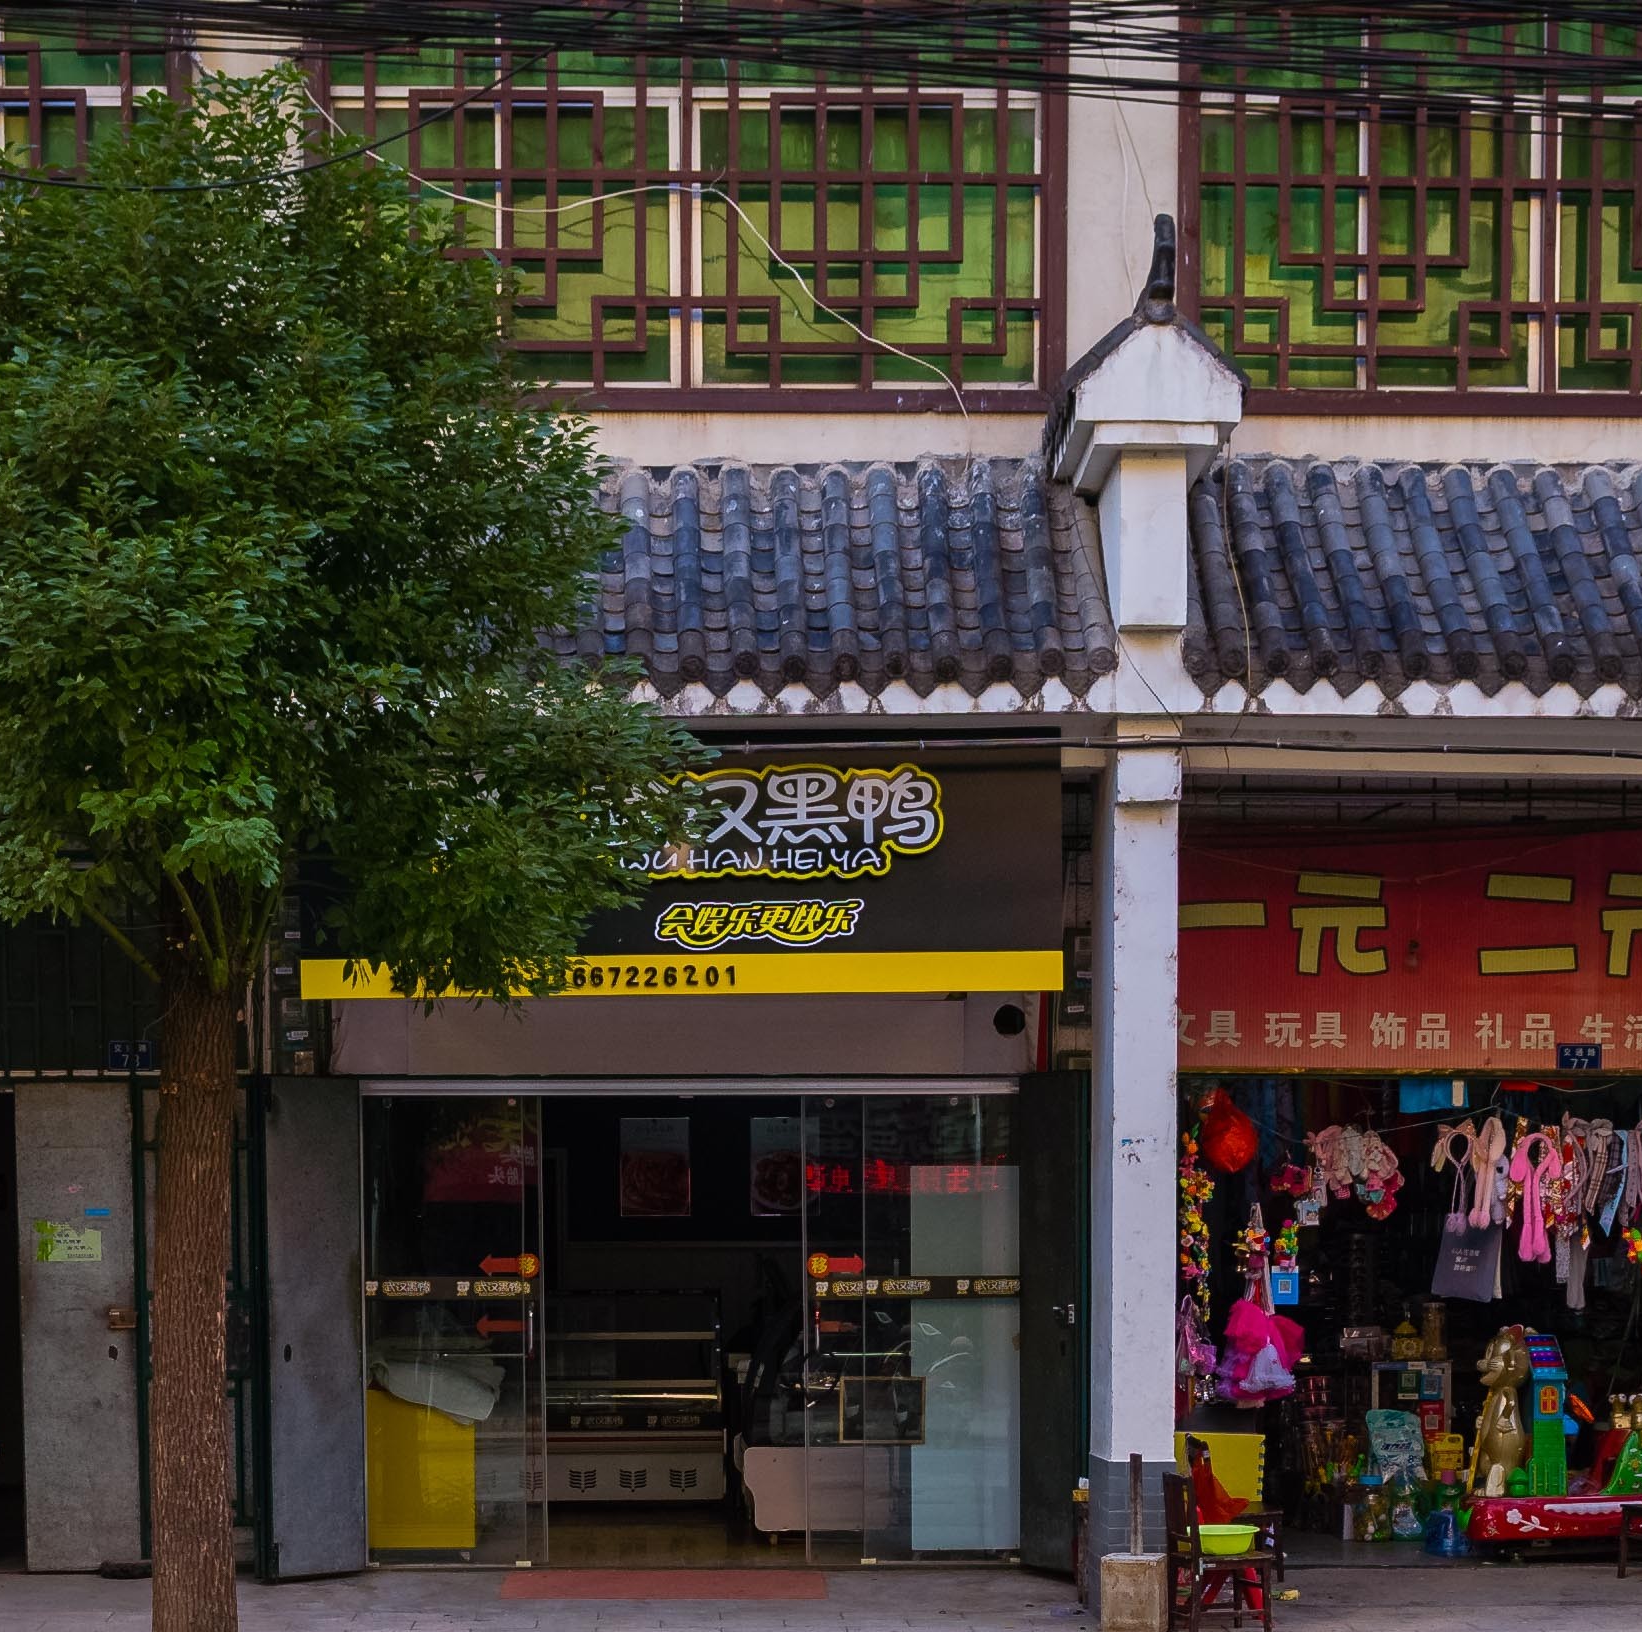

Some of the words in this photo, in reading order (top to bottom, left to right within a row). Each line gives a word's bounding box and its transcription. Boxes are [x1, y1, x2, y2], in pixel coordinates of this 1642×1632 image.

[592, 770, 940, 847] 汉黑鸭
[687, 849, 763, 870] HAN
[769, 848, 823, 870] HEI
[827, 848, 882, 870] YA
[660, 903, 859, 947] 会娱乐更快乐
[1178, 871, 1389, 977] 一元
[555, 964, 737, 988] 667226201
[1264, 1010, 1347, 1050] 玩具
[1369, 1010, 1452, 1050] 饰品
[1474, 1010, 1557, 1050] 礼品
[1569, 1058, 1590, 1070] 77
